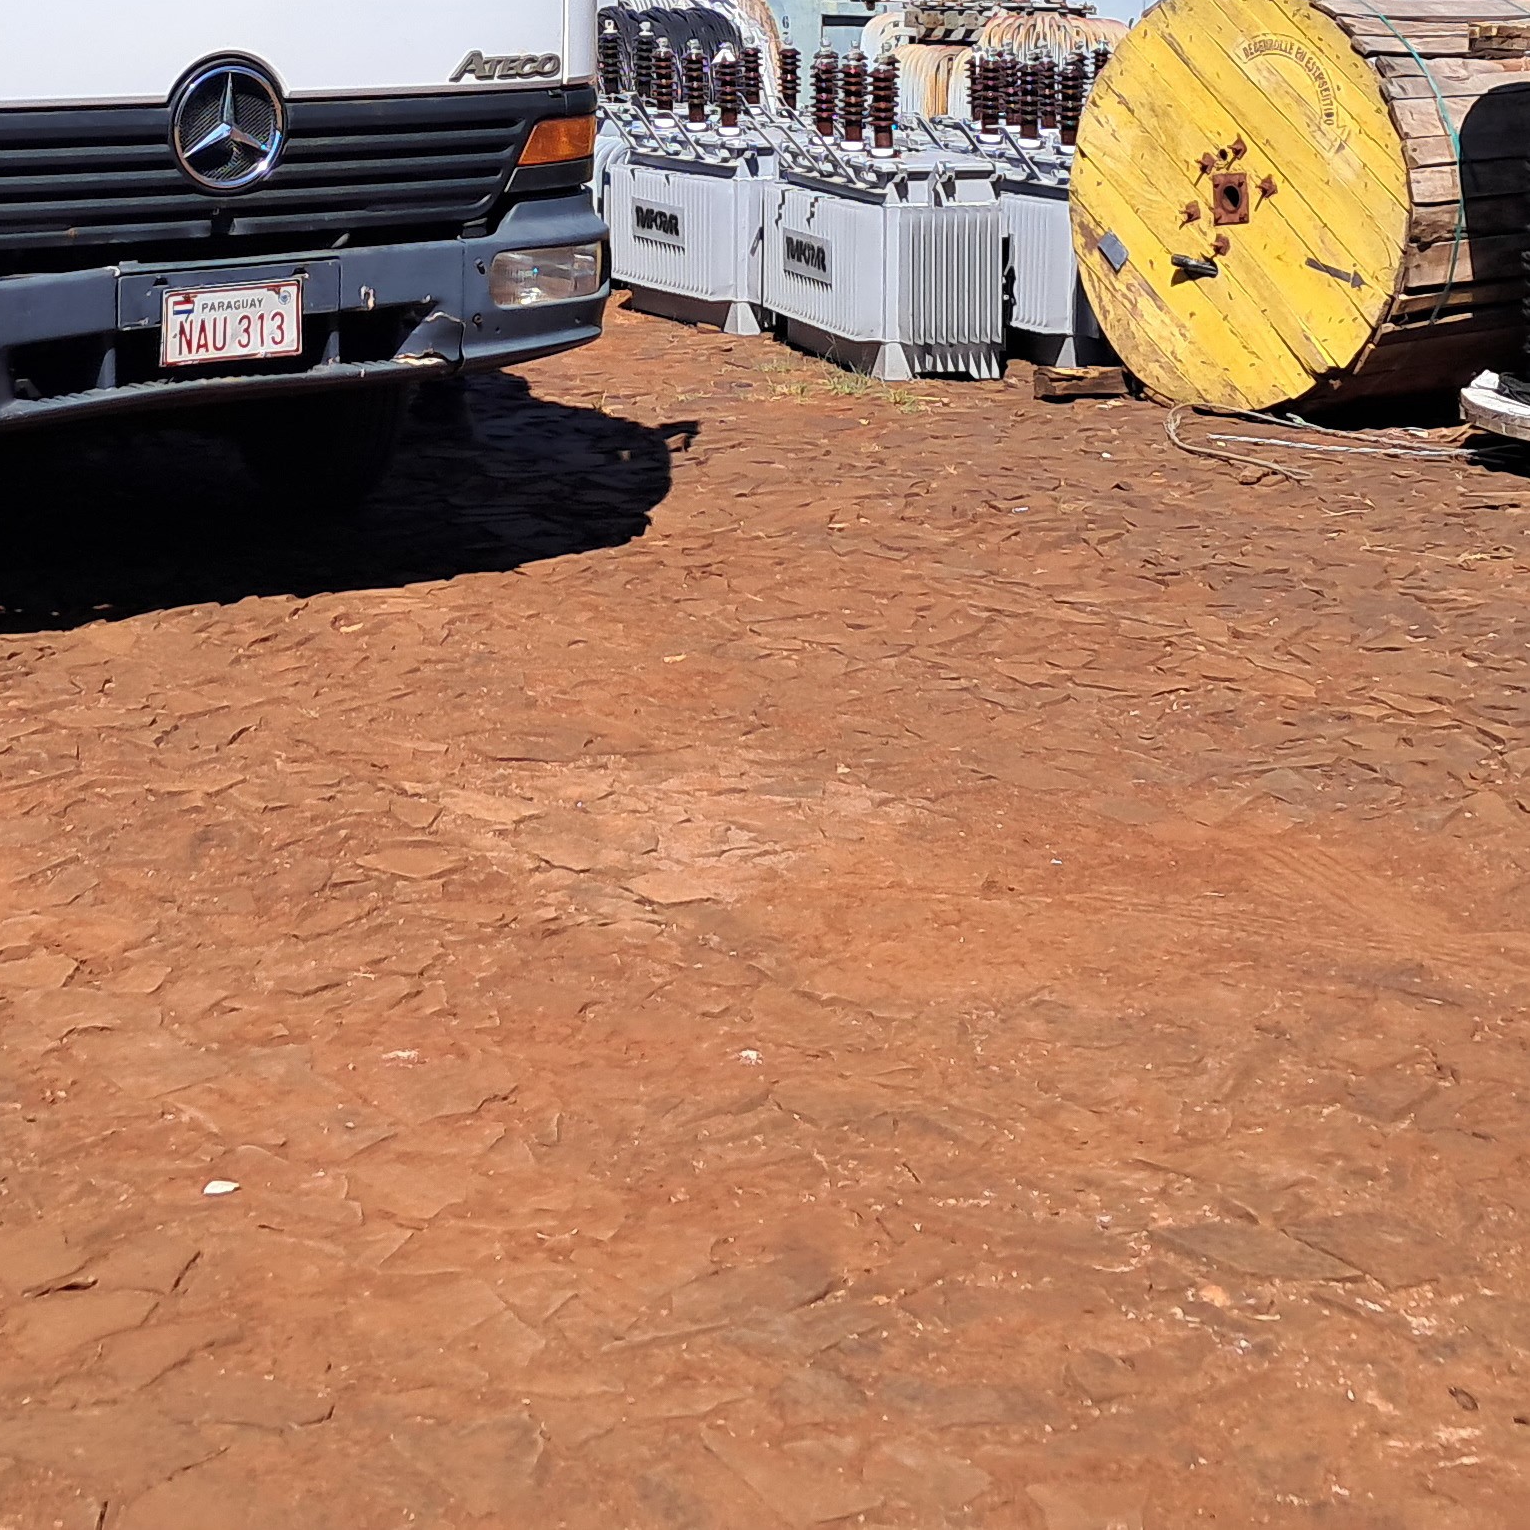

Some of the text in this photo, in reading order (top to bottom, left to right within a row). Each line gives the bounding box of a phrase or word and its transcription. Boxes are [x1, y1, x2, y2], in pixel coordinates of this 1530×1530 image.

[201, 297, 265, 313] PARAGUAY
[178, 311, 285, 356] NAU 313
